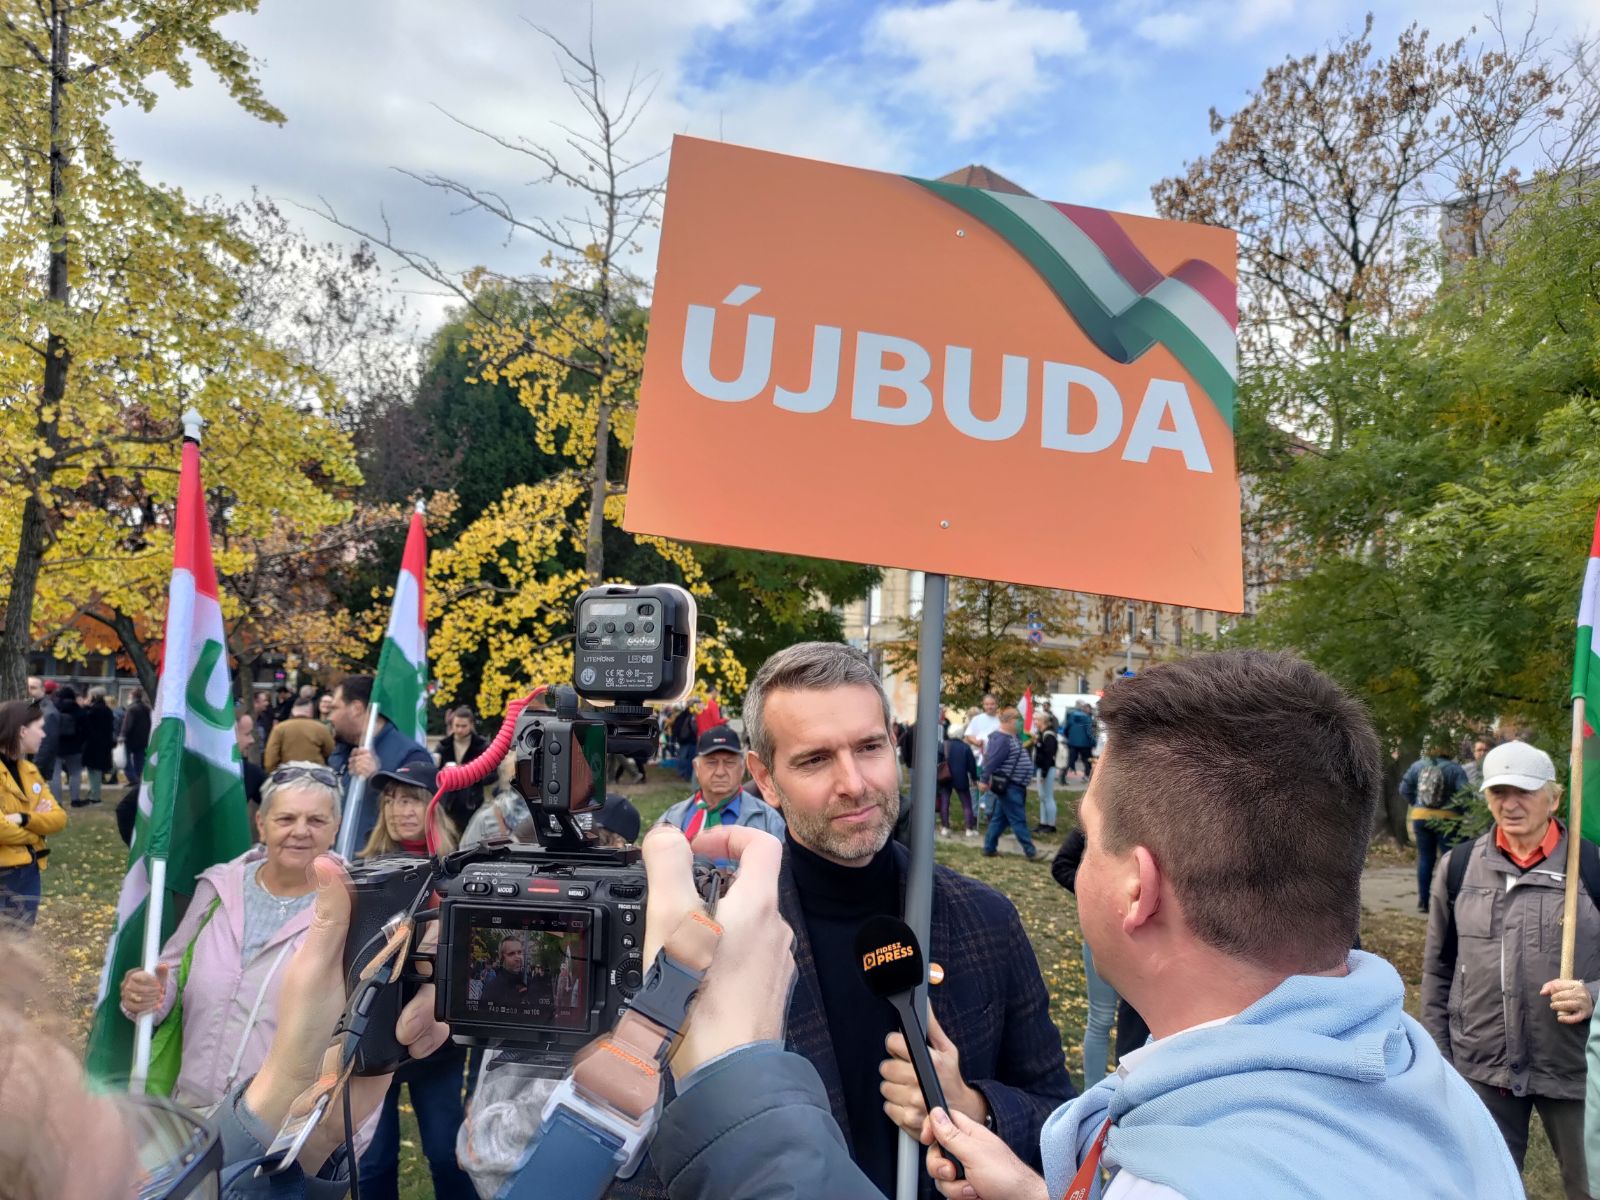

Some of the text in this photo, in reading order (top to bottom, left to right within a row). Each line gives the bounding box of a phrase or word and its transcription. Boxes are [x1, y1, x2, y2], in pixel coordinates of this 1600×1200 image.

[681, 284, 1213, 473] ÚJBUDA
[625, 914, 631, 922] 5
[623, 938, 632, 946] Fn
[876, 942, 902, 956] FIDESZ
[877, 945, 913, 965] PRESS
